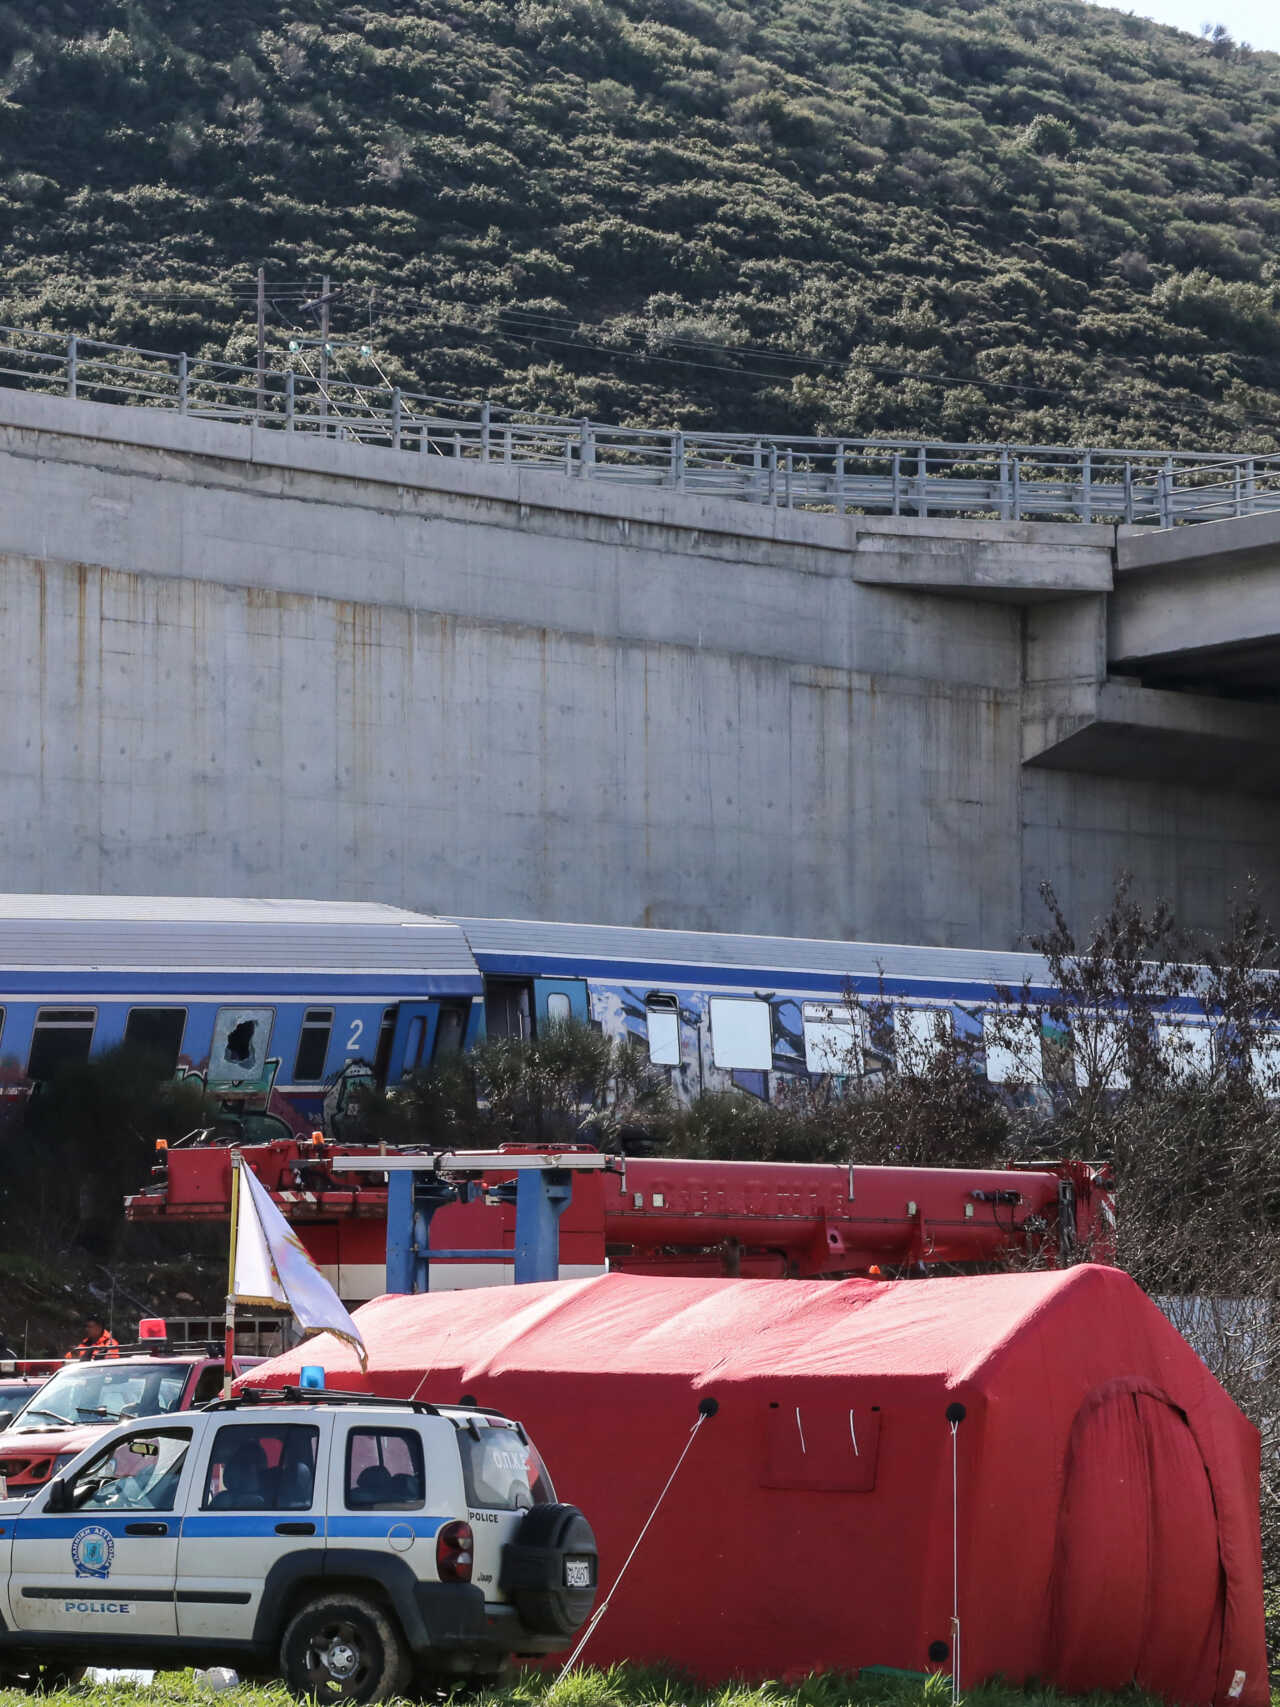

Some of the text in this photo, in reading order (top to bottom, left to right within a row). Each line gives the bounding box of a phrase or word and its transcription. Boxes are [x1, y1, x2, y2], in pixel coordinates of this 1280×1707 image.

[346, 1018, 364, 1050] 2
[469, 1511, 499, 1524] POLICE
[64, 1601, 131, 1614] POLICE
